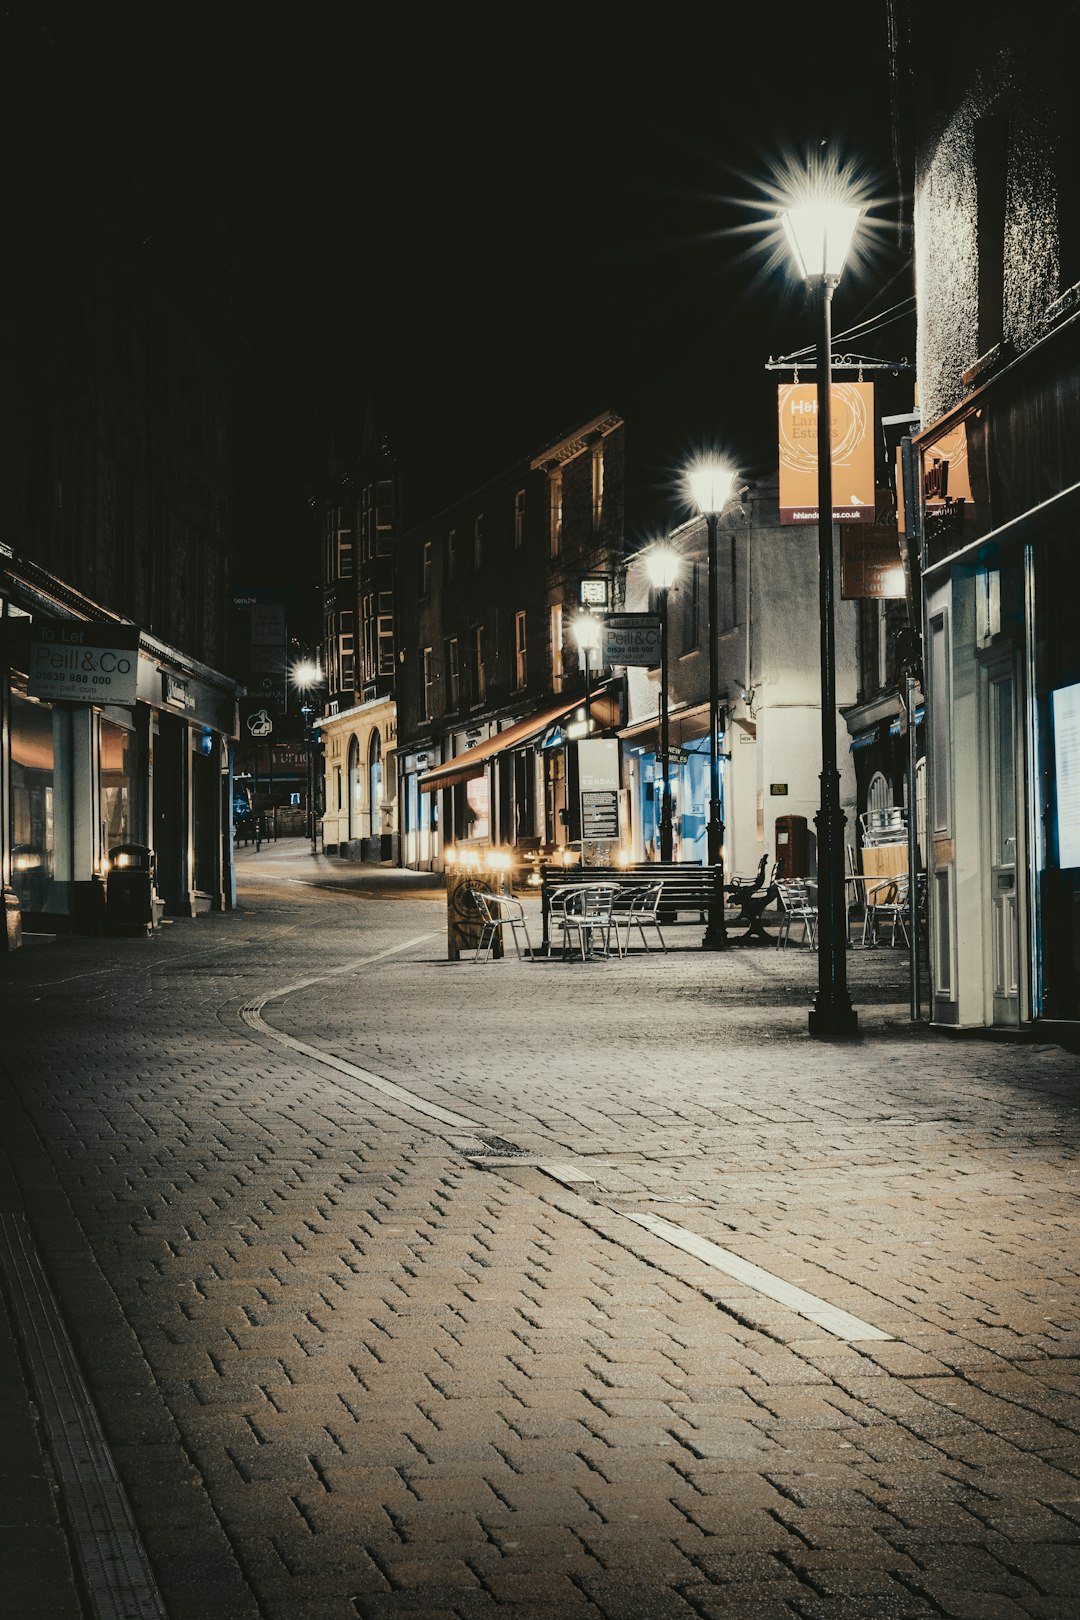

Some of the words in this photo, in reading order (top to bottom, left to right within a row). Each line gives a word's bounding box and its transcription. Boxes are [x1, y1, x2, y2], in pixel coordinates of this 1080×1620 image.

[793, 415, 818, 426] Lan
[793, 428, 839, 439] Estas
[40, 626, 55, 641] To
[62, 628, 84, 644] Let
[35, 671, 65, 682] 01539
[69, 674, 88, 684] 888
[92, 676, 112, 686] 000
[668, 746, 682, 755] NEW
